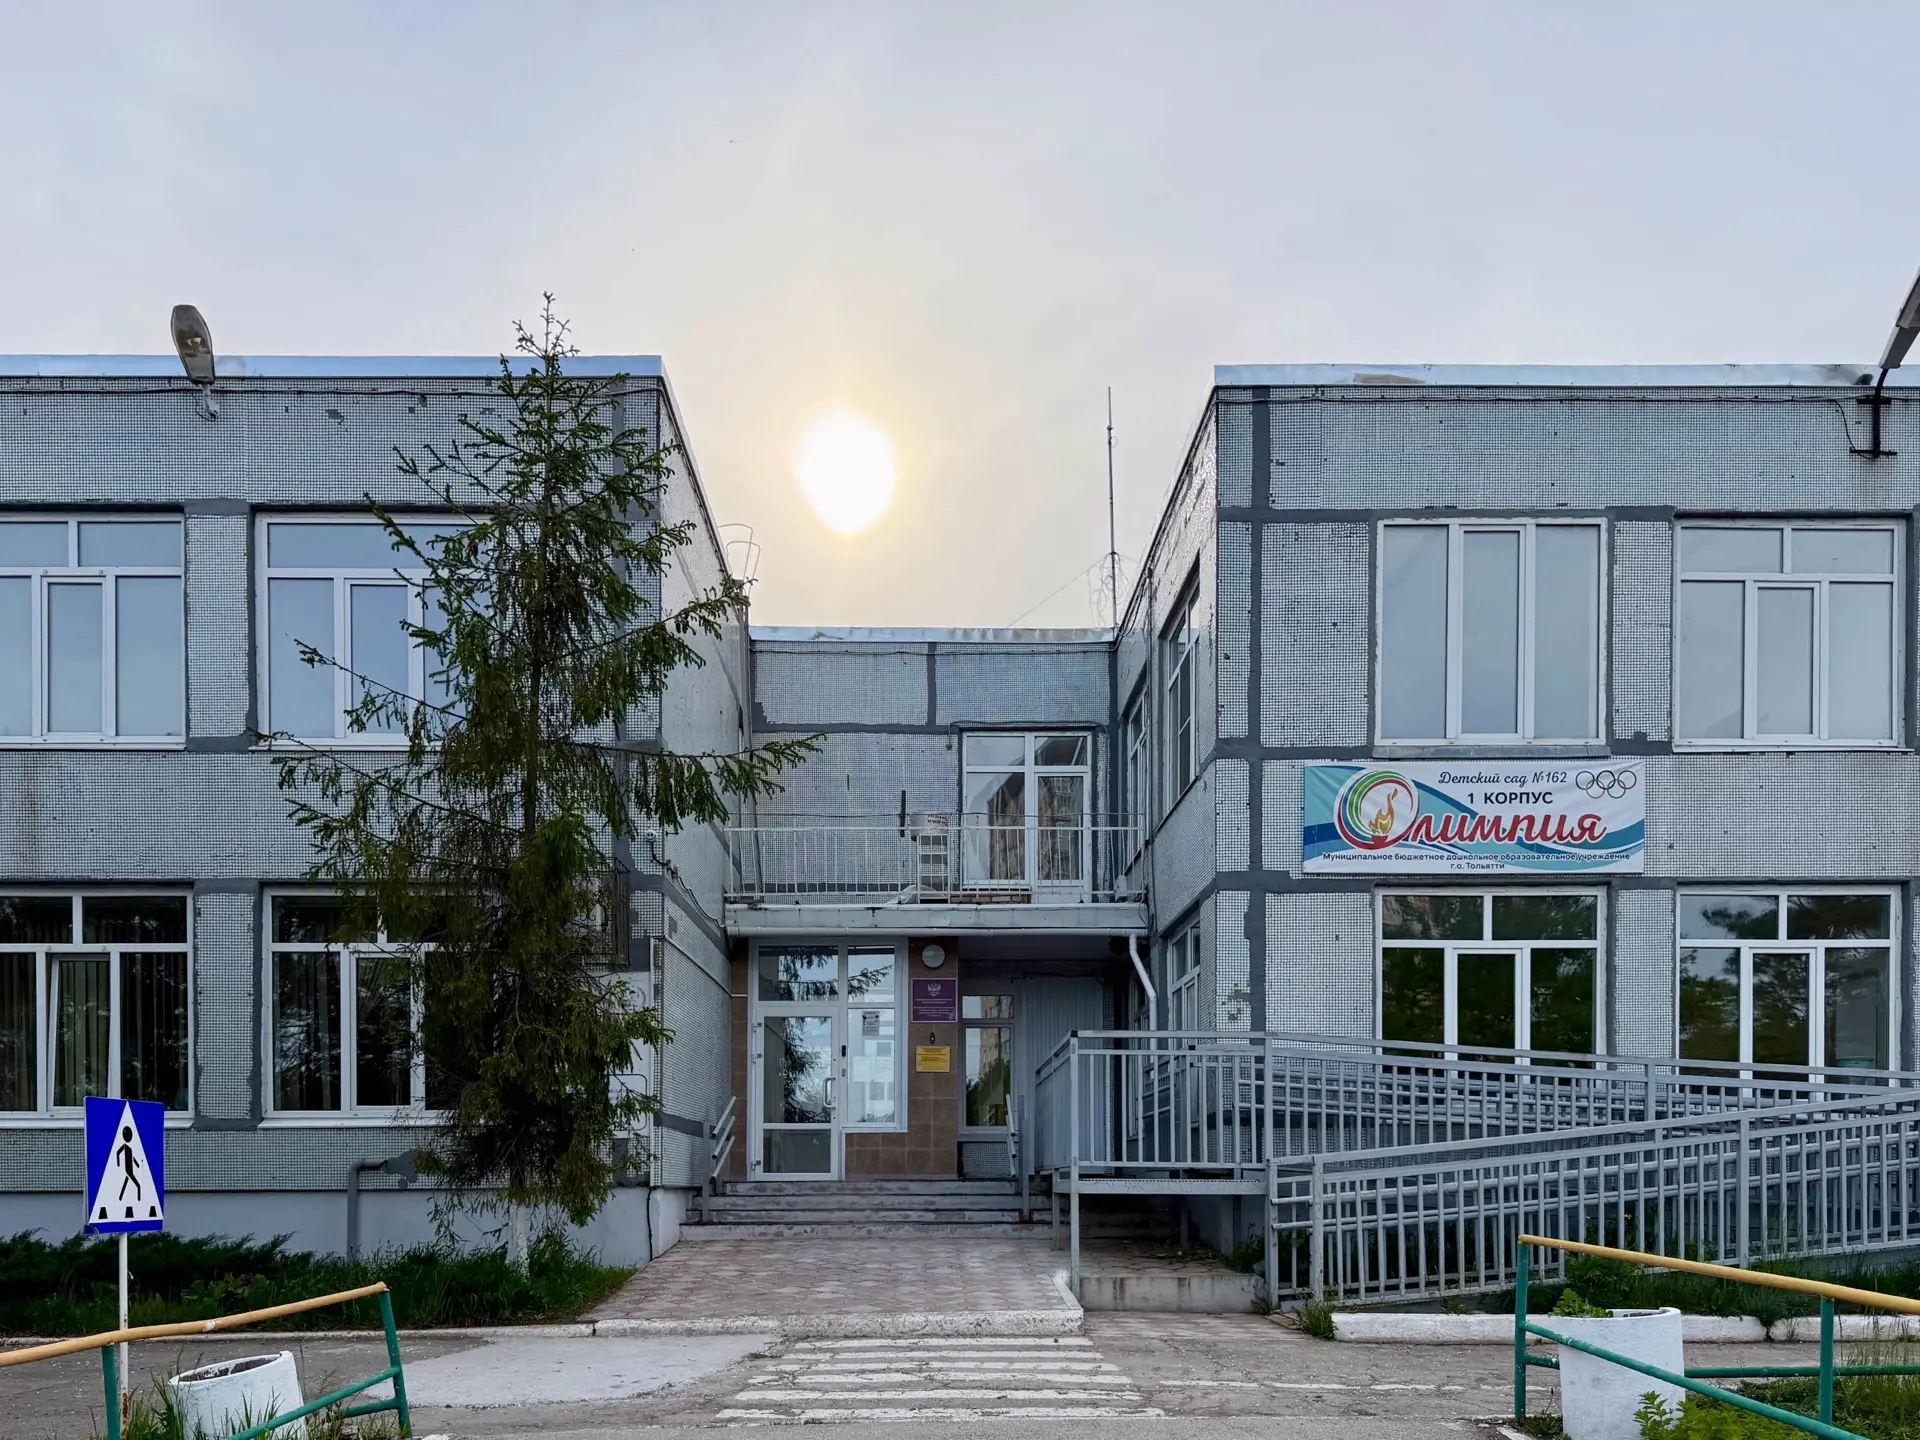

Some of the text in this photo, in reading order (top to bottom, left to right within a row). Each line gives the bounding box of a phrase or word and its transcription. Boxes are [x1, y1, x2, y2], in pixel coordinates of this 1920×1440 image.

[1438, 771, 1501, 784] Детский
[1504, 774, 1529, 787] сад
[1467, 791, 1554, 805] 1 КОРПУС
[1322, 853, 1630, 863] Муниципальное бюджетное дошкольное образовательное учреждение
[1467, 862, 1505, 870] Тольятти
